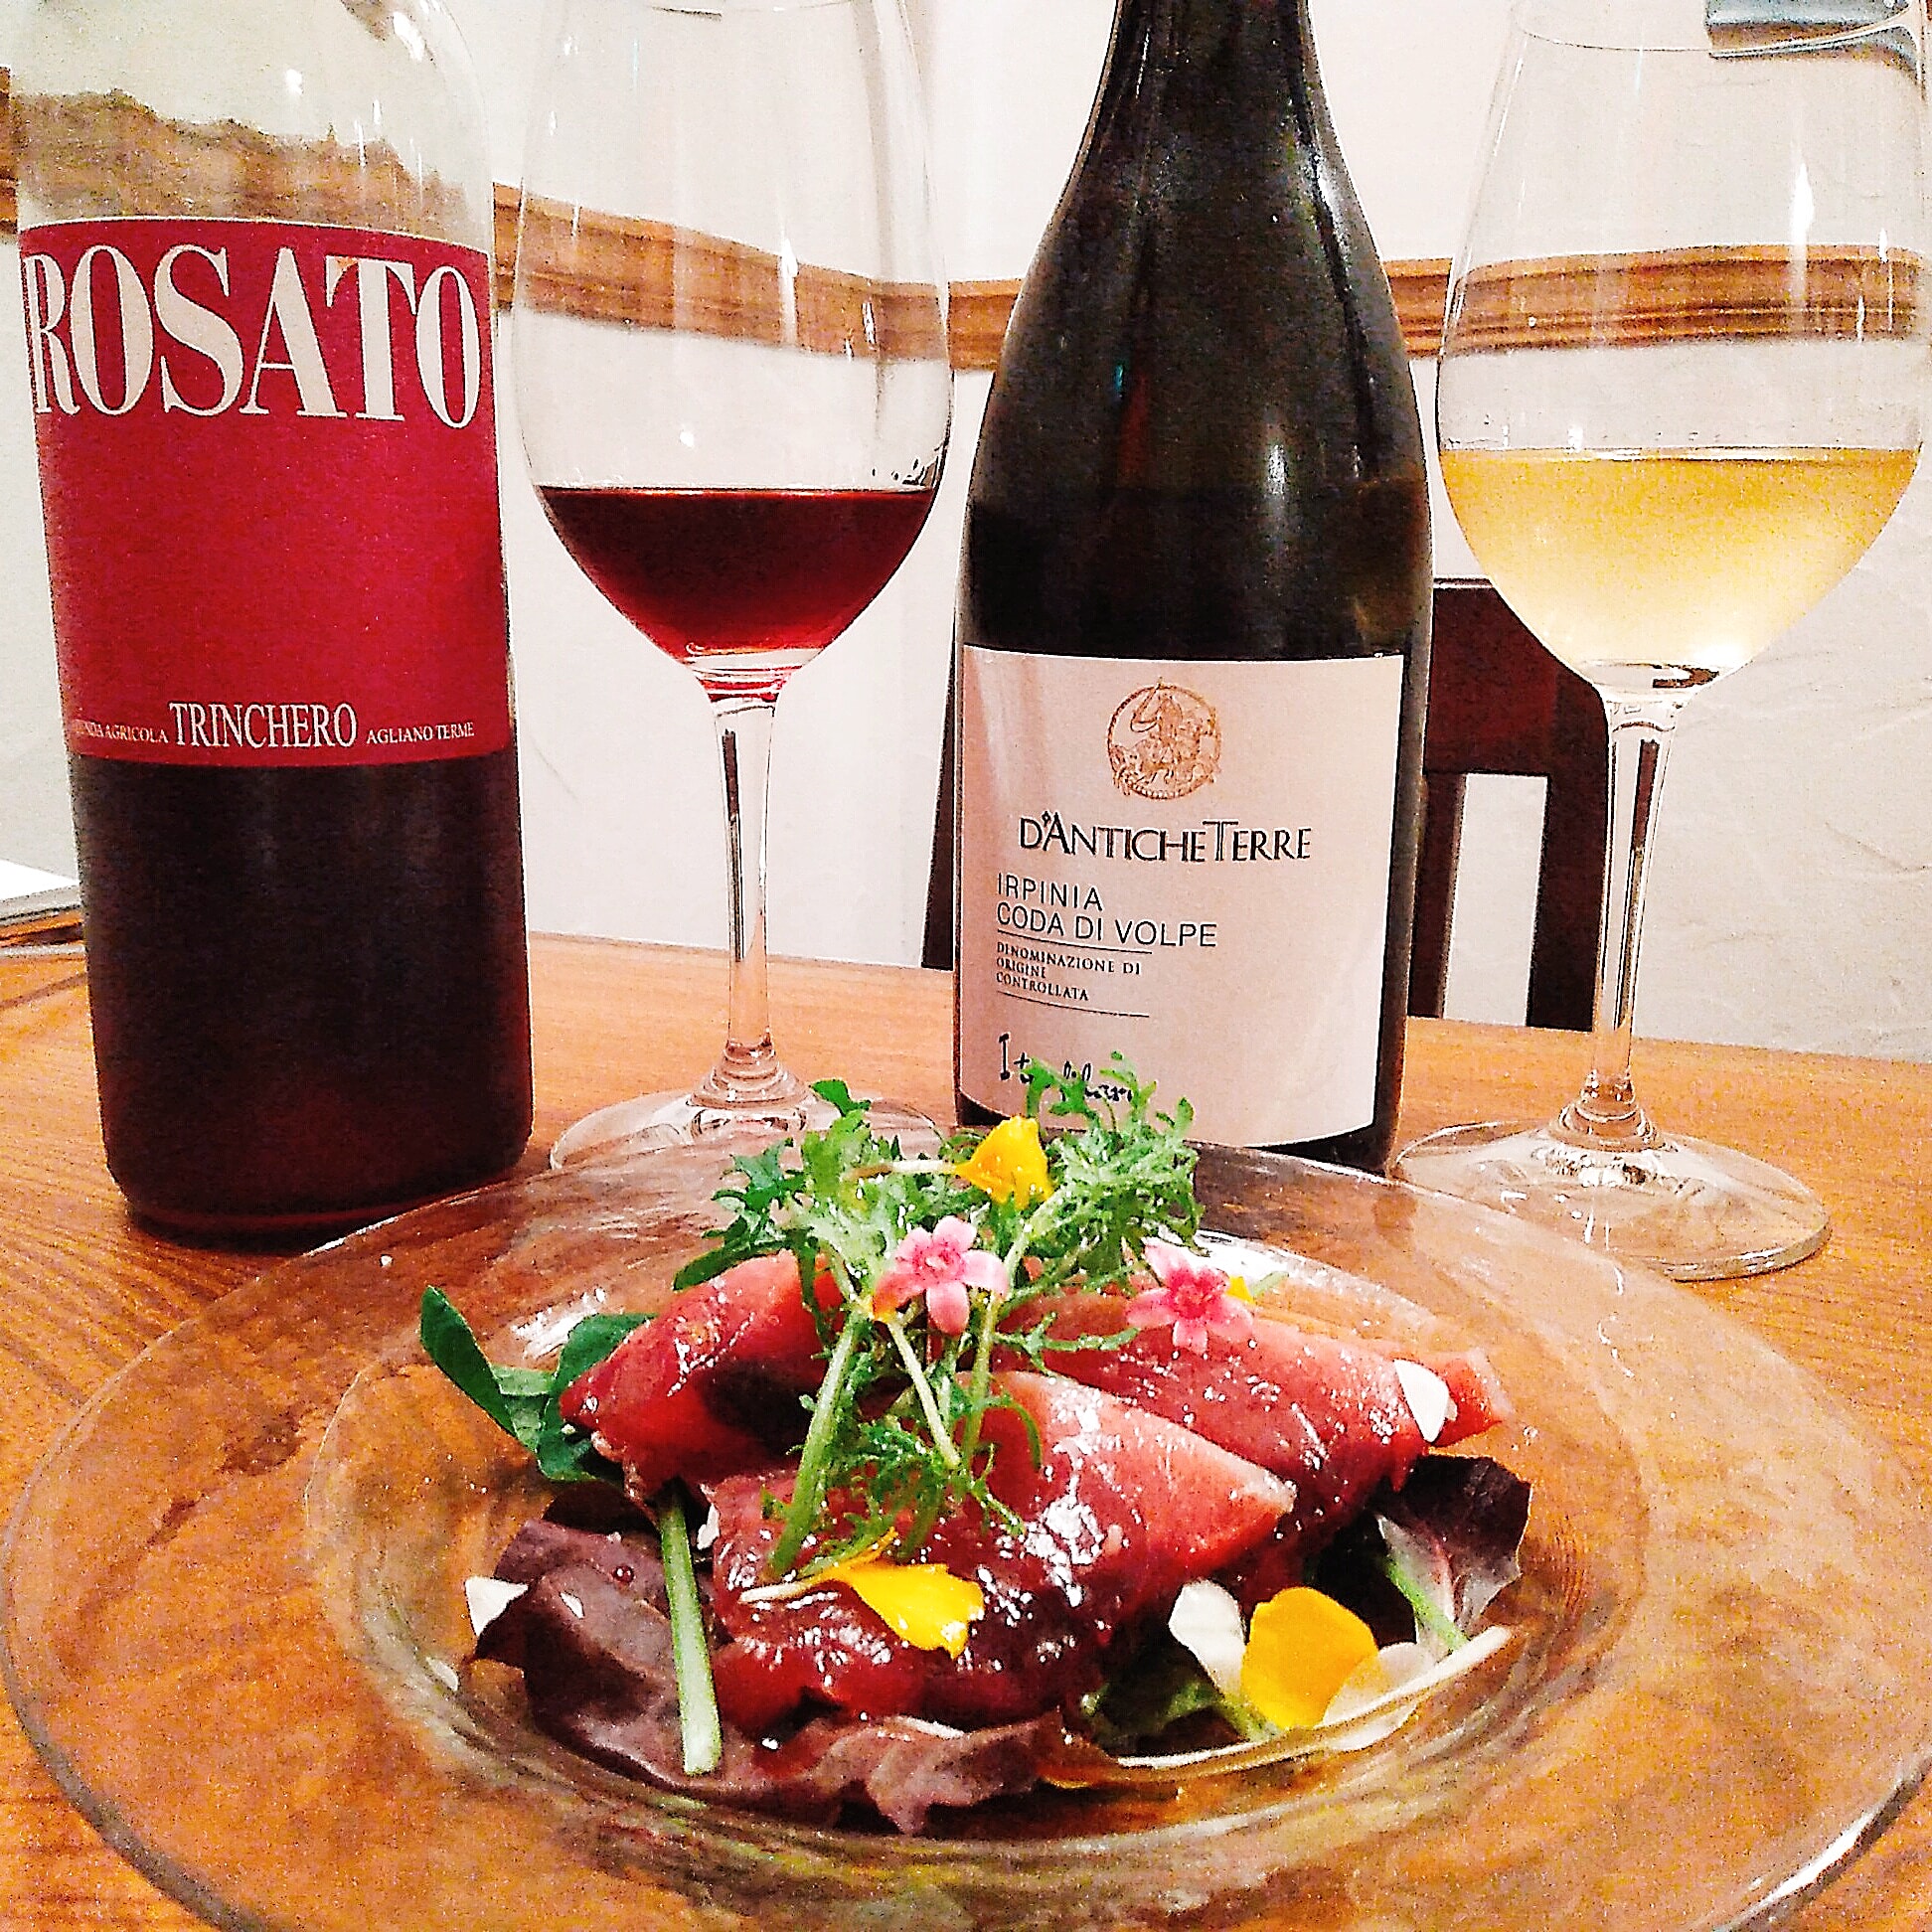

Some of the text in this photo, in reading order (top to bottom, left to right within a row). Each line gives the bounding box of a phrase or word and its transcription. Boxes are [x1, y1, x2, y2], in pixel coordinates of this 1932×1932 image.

[22, 244, 482, 429] ROSATO
[104, 723, 170, 744] AGRICOLA
[168, 702, 357, 748] TRINCHERO
[366, 724, 433, 744] AGLIANO
[435, 721, 475, 740] TERME
[997, 872, 1103, 911] IRPINIA
[996, 901, 1217, 947] CODA DI VOLPE
[995, 971, 1090, 1002] CONTROLLATA
[996, 956, 1046, 979] ORIGINE
[1122, 962, 1142, 976] DI
